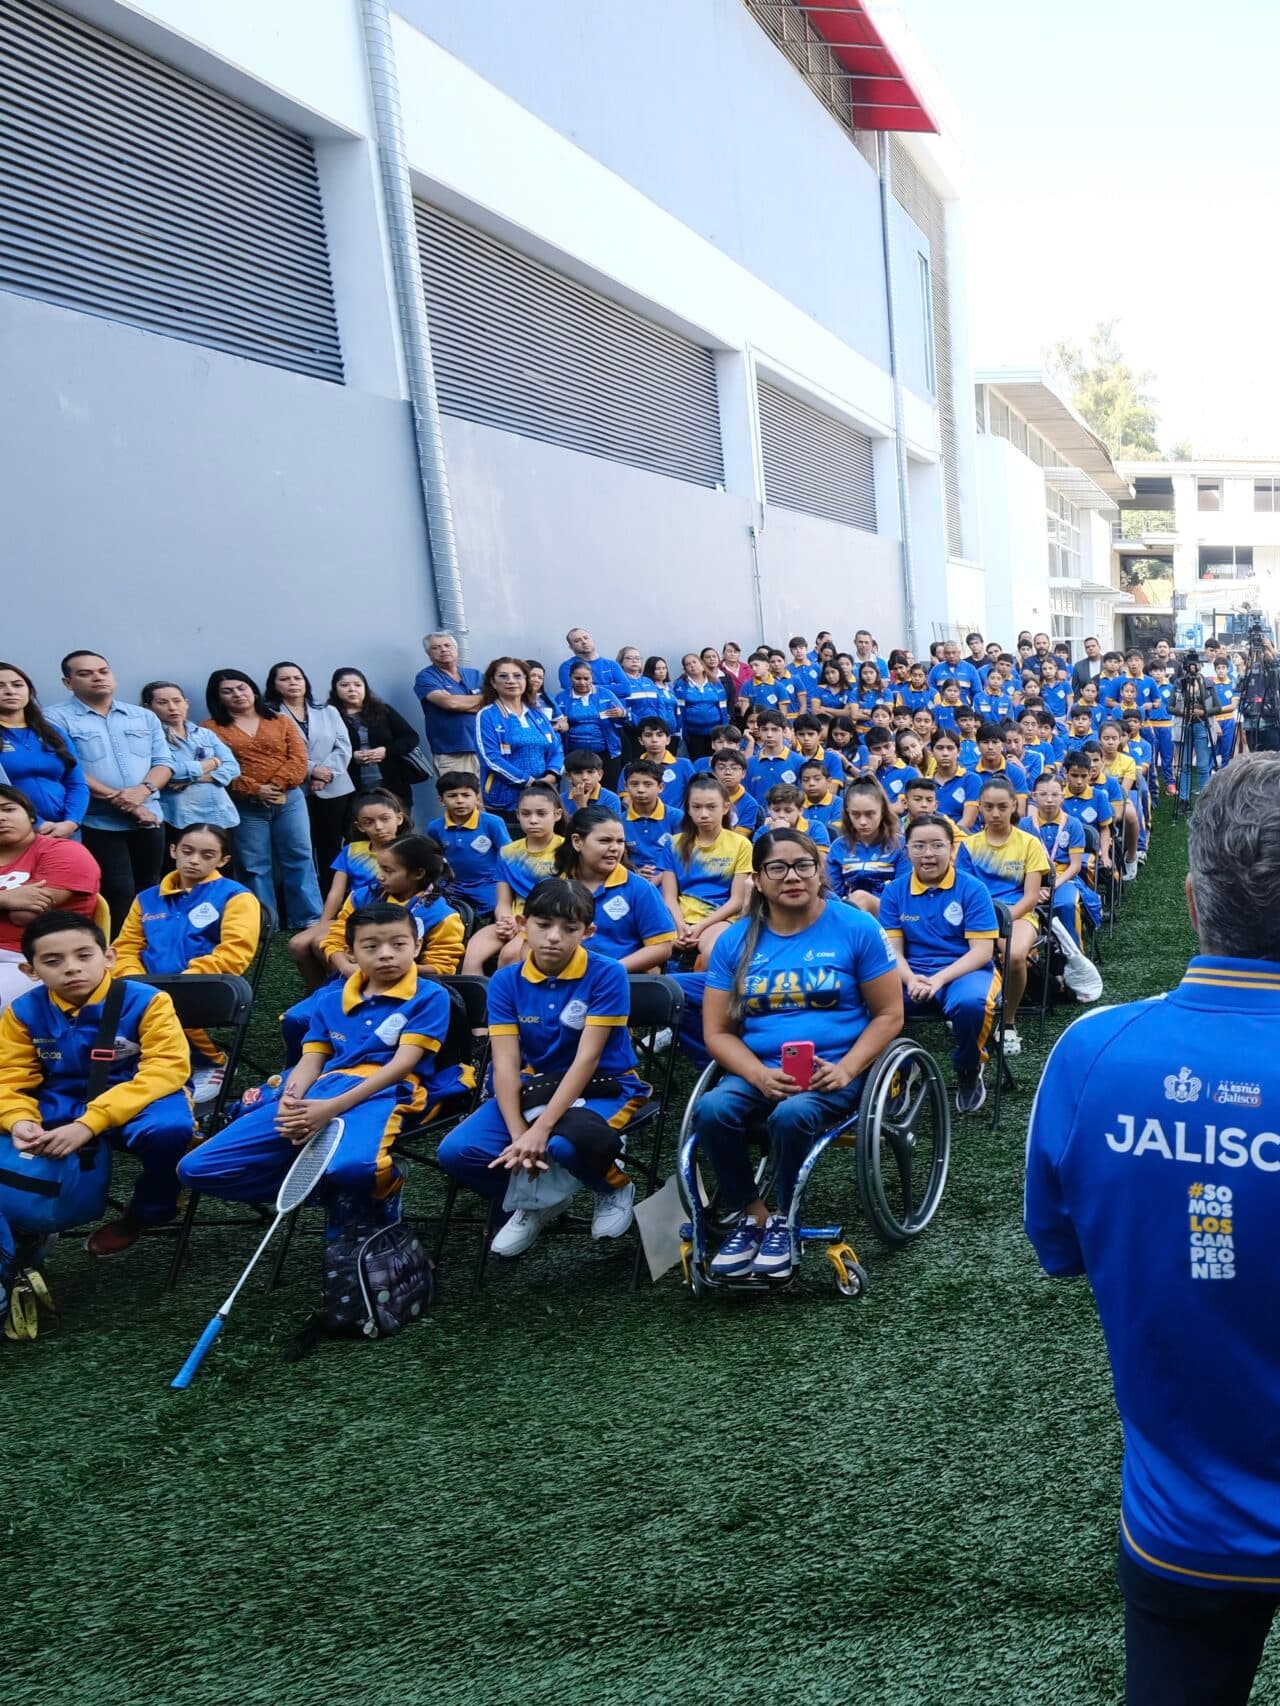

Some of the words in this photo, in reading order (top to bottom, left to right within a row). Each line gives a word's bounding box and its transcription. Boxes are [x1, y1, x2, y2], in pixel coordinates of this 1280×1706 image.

[1218, 1084, 1229, 1092] AL
[1230, 1085, 1260, 1095] ESTILO
[1218, 1092, 1258, 1104] Jalisco
[1187, 1182, 1233, 1202] #SO
[1188, 1200, 1233, 1218] MOS
[1190, 1215, 1233, 1234] LOS
[1190, 1233, 1234, 1249] CAM
[1190, 1247, 1235, 1264] PEO
[1191, 1263, 1236, 1280] NES
